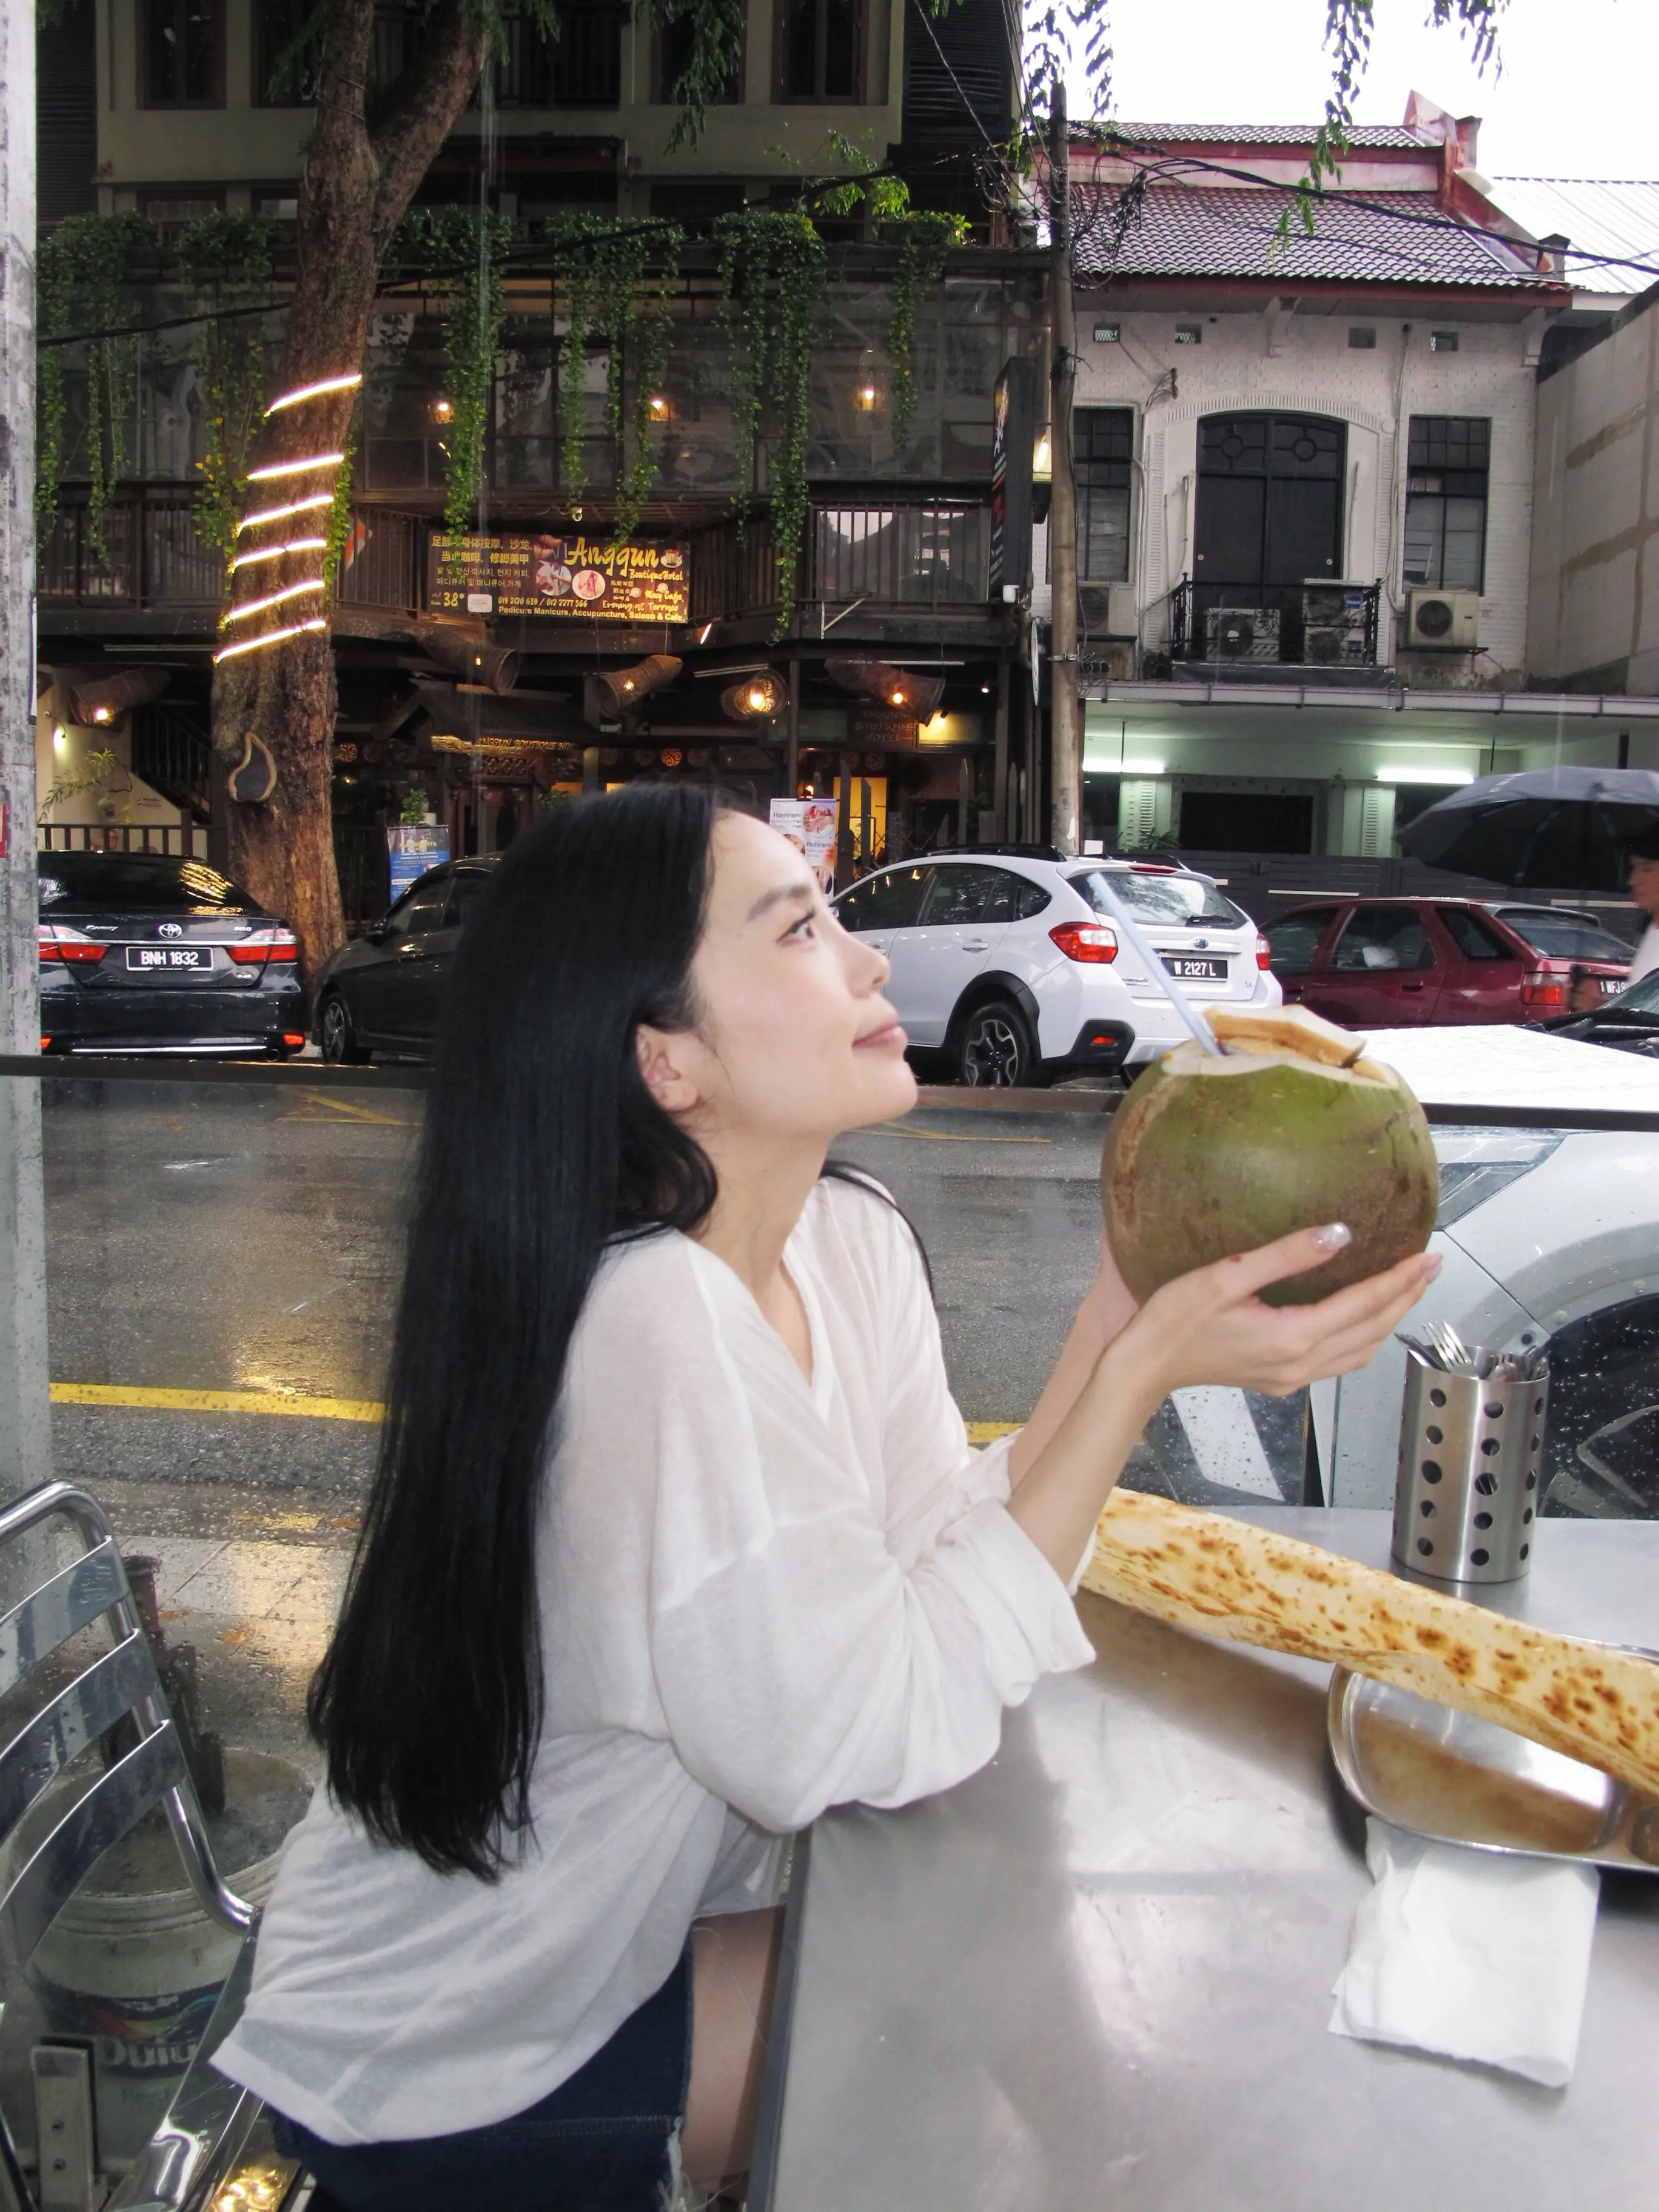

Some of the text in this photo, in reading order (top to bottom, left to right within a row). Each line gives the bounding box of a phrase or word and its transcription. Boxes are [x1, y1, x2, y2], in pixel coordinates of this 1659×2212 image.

[564, 536, 659, 577] Anggun
[629, 611, 655, 620] Saloon
[557, 742, 579, 751] HOT
[141, 951, 199, 965] BNH 1832
[1174, 961, 1216, 976] W 2127 L
[93, 2036, 198, 2068] Dulu
